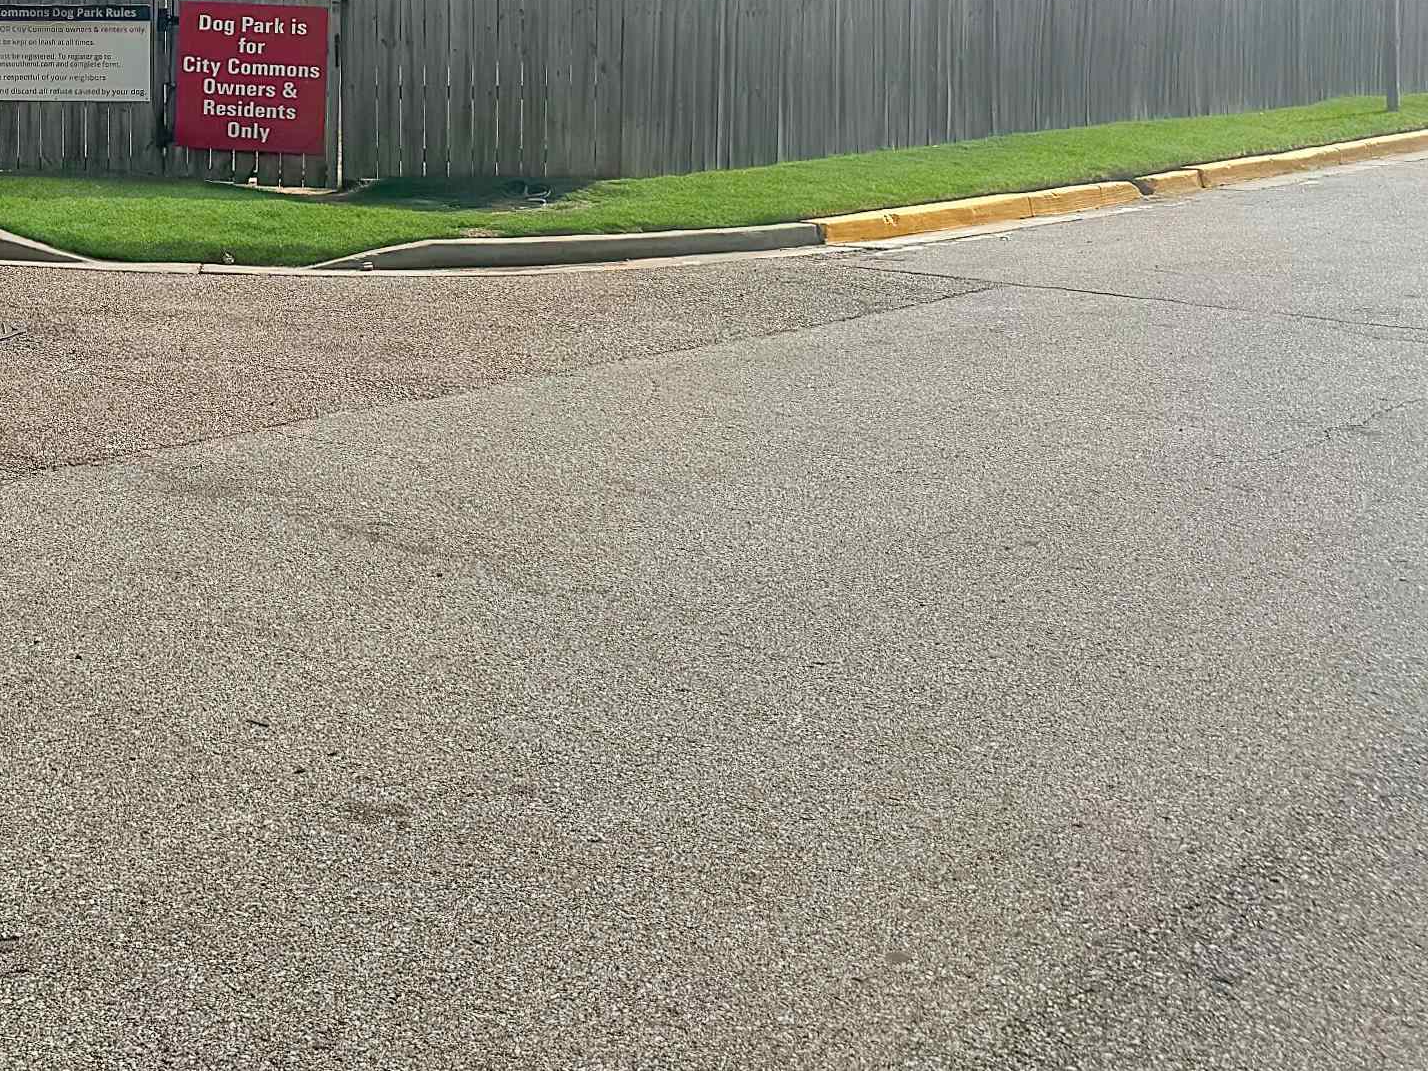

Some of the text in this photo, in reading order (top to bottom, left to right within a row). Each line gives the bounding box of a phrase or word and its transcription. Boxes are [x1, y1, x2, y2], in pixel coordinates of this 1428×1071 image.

[52, 8, 74, 20] Dog
[77, 7, 103, 18] Park
[106, 7, 137, 18] Rules
[199, 14, 308, 36] Dog Park is
[238, 37, 266, 54] for
[183, 56, 321, 79] City Commons
[203, 78, 298, 99] Owners &
[203, 99, 297, 120] Residents
[227, 121, 270, 144] Only
